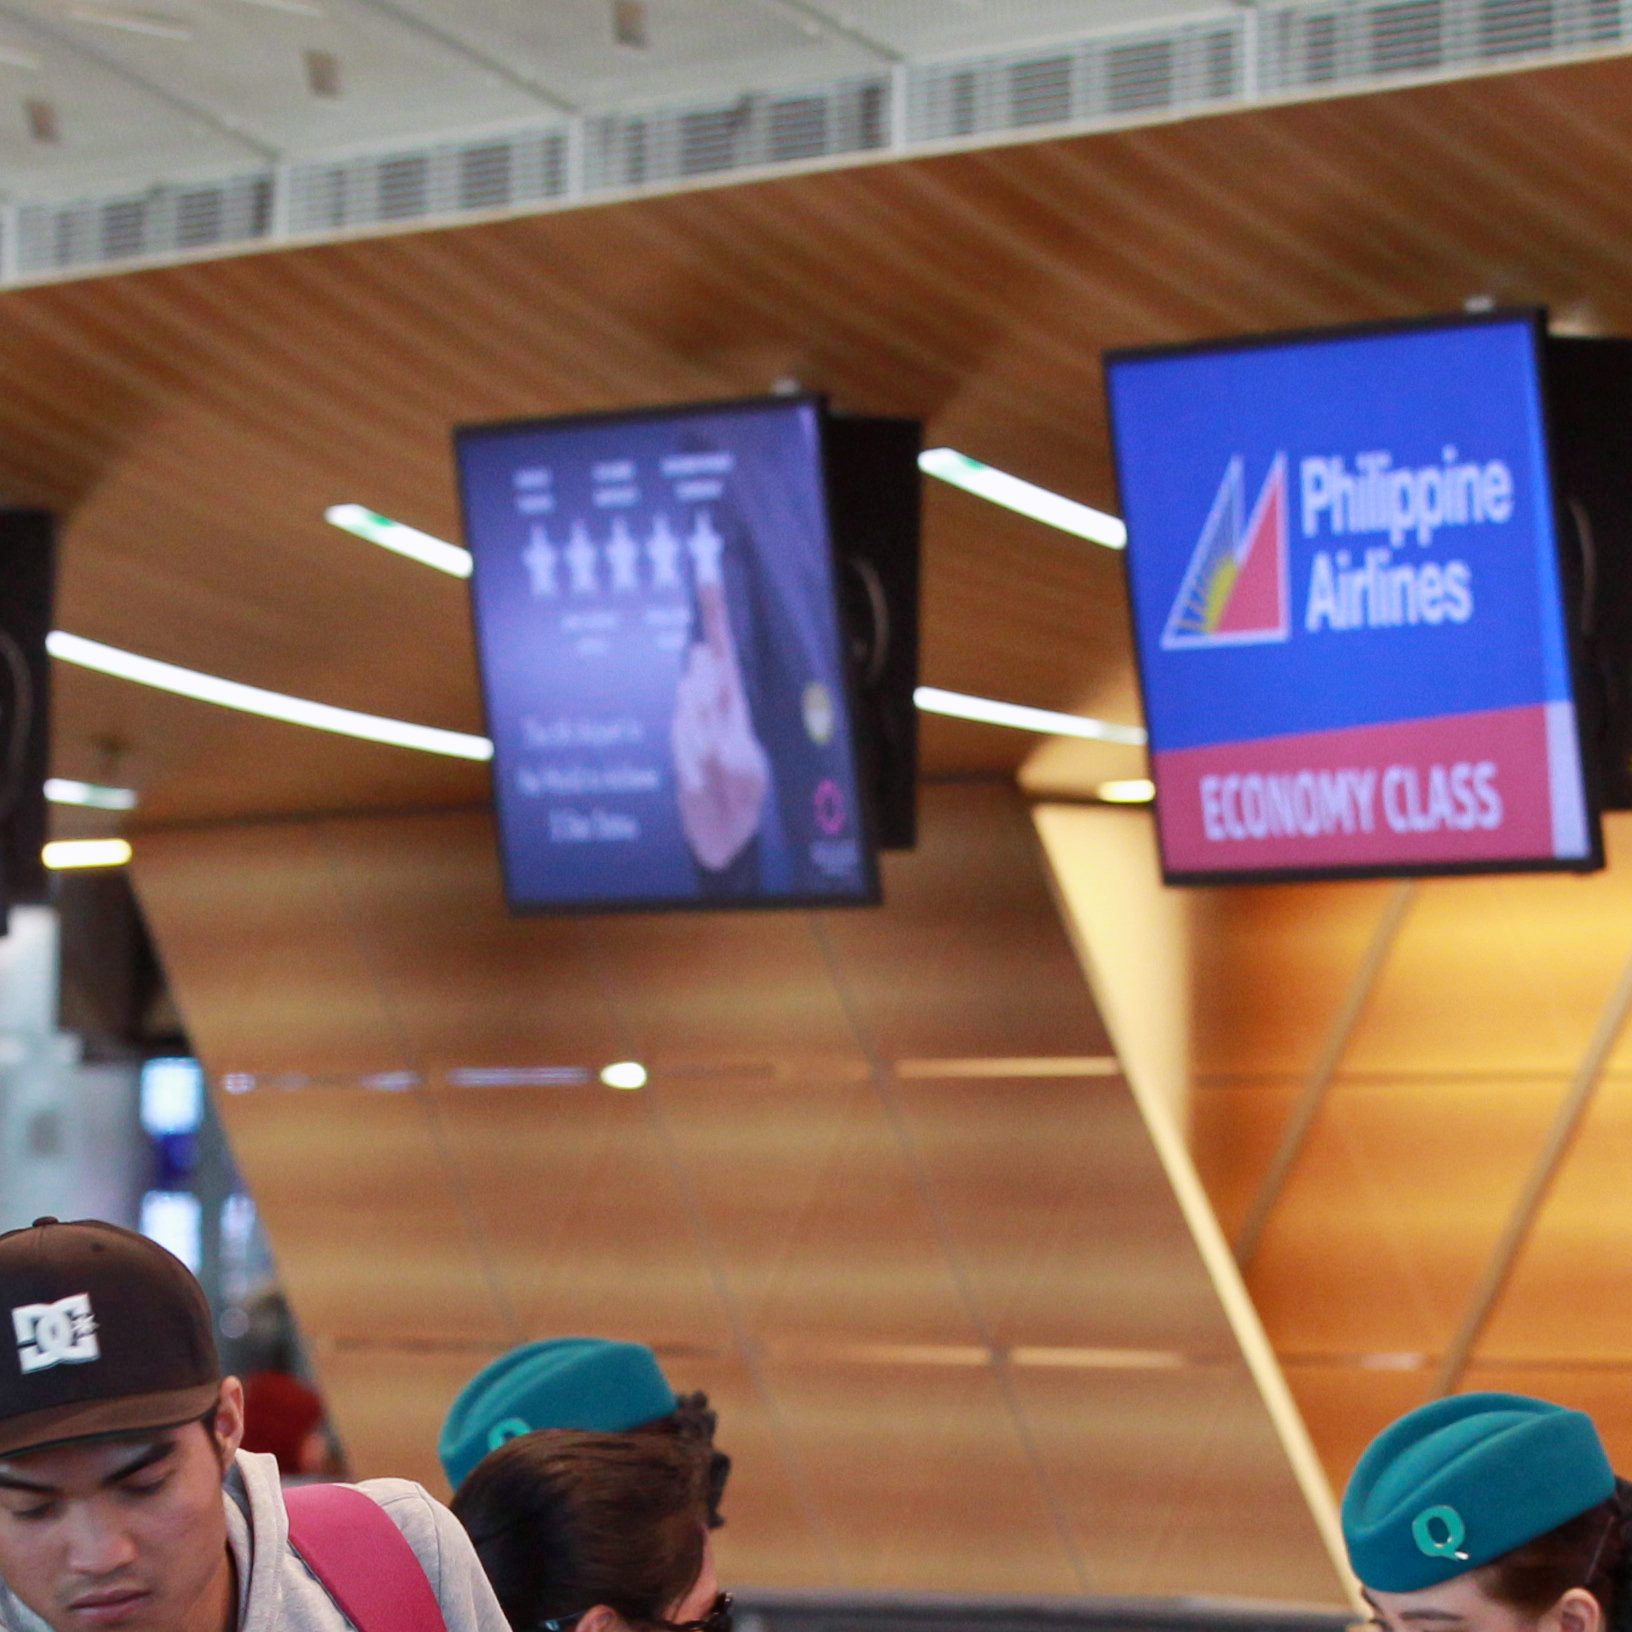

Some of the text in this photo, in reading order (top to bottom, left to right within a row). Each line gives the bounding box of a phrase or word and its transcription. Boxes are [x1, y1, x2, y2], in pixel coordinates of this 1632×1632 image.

[1301, 445, 1514, 548] Philippine
[1305, 548, 1474, 632] Airlines
[1200, 761, 1504, 841] ECONOMY CLASS
